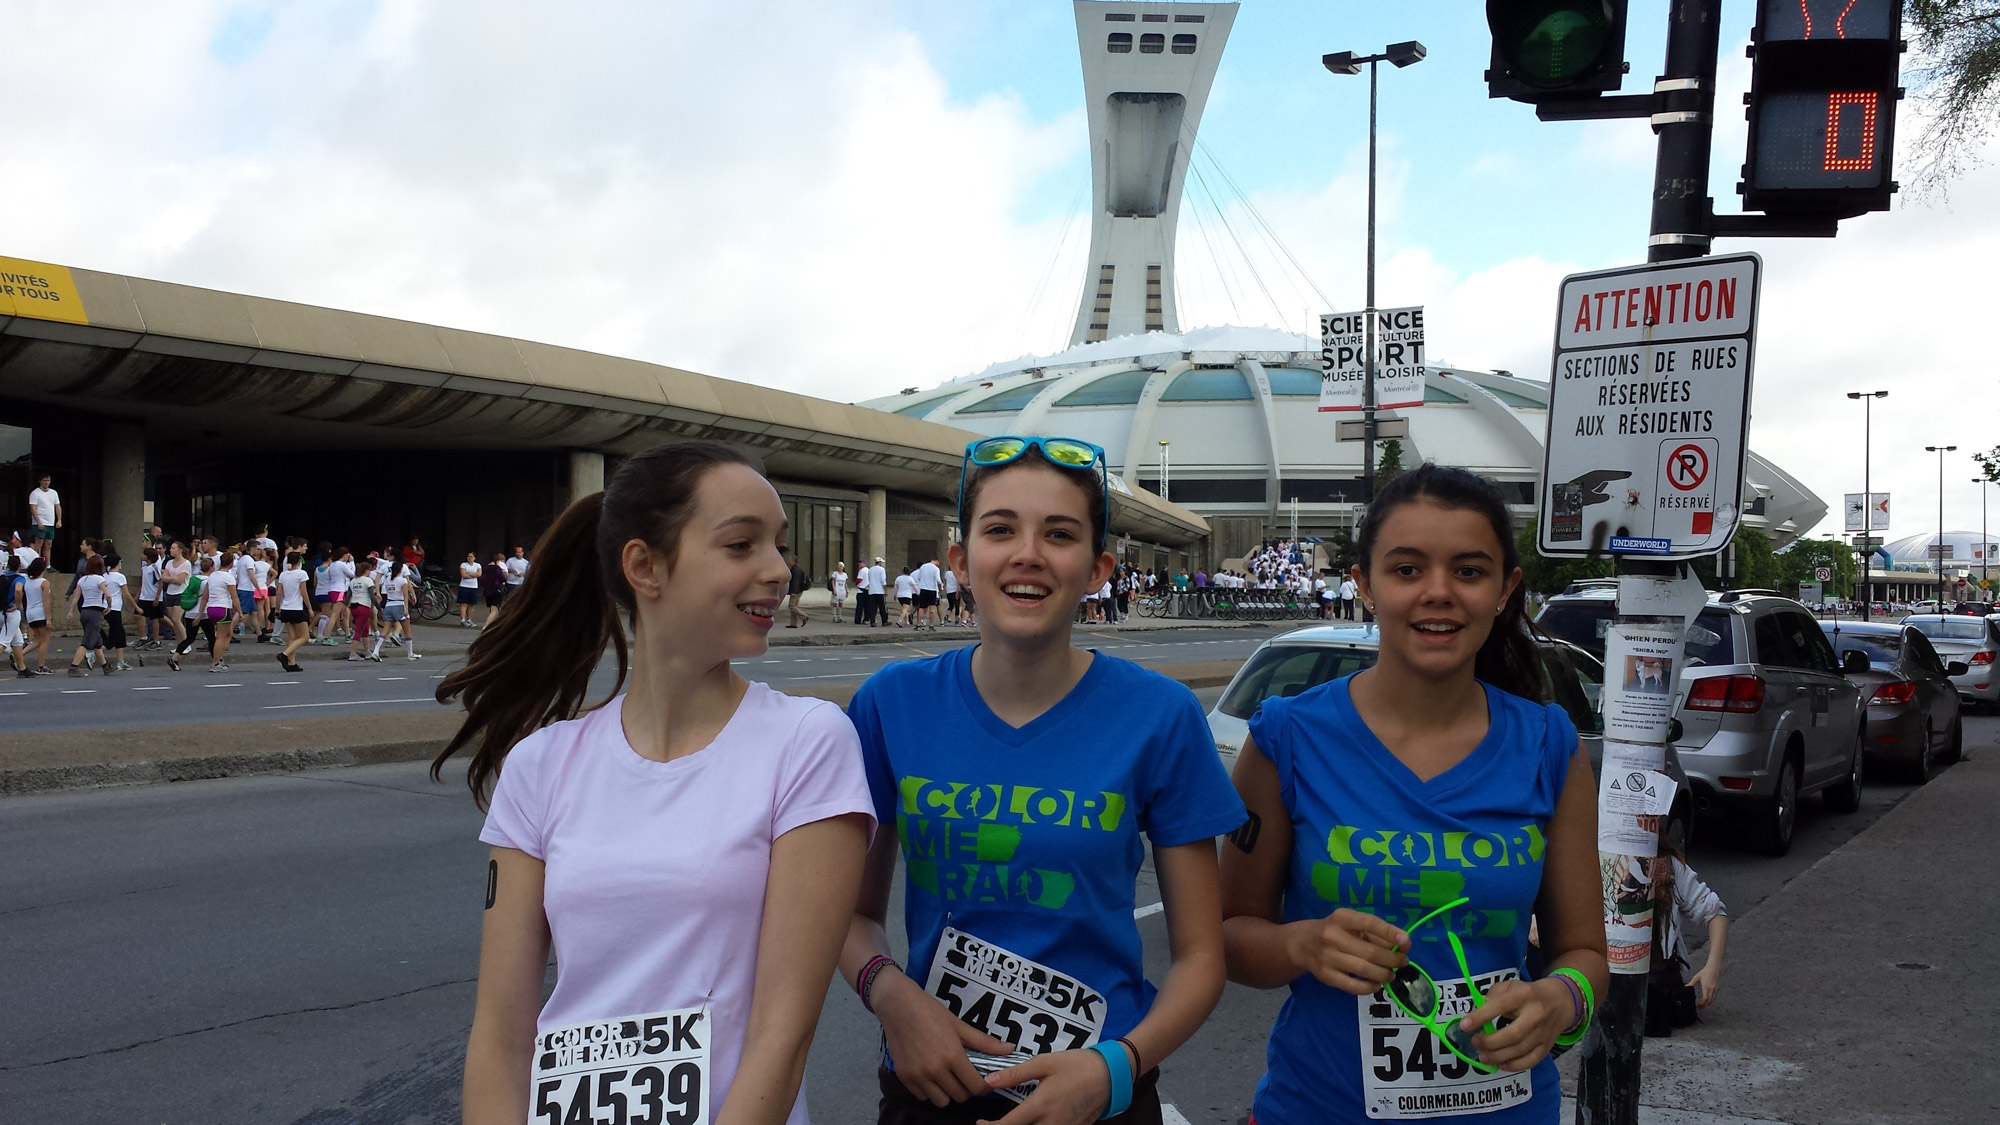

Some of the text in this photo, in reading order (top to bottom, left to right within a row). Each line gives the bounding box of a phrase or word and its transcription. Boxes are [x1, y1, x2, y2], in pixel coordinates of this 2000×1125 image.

[1824, 92, 1878, 171] 0
[17, 286, 60, 302] TOUS
[1574, 277, 1737, 334] ATTENTION
[1322, 335, 1363, 347] NATURE
[1322, 366, 1425, 383] MUSÉE LOISIR
[1564, 346, 1737, 380] SECTIONS DE RUES
[1384, 384, 1410, 393] Montréal
[1598, 375, 1691, 406] RÉSERVÉES
[1575, 407, 1713, 437] AUX RÉSIDENTS
[1660, 493, 1710, 509] RÉSERVÉ
[1612, 539, 1668, 549] UNDERWORLD
[1652, 637, 1676, 645] PERDU
[915, 778, 1106, 831] COLOR
[906, 816, 978, 860] ME
[1349, 826, 1536, 868] COLOR
[938, 860, 1043, 906] RAD
[1338, 866, 1420, 905] ME
[964, 939, 1034, 981] COLOR
[964, 957, 1041, 1000] ME RAD
[1045, 974, 1100, 1024] 5K
[550, 1022, 624, 1050] COLOR
[642, 1012, 703, 1055] 5K
[1372, 1015, 1514, 1082] 545
[555, 1040, 637, 1069] ME RAD
[536, 1062, 702, 1125] 54539
[1398, 1086, 1503, 1111] COLORMERAD.COM
